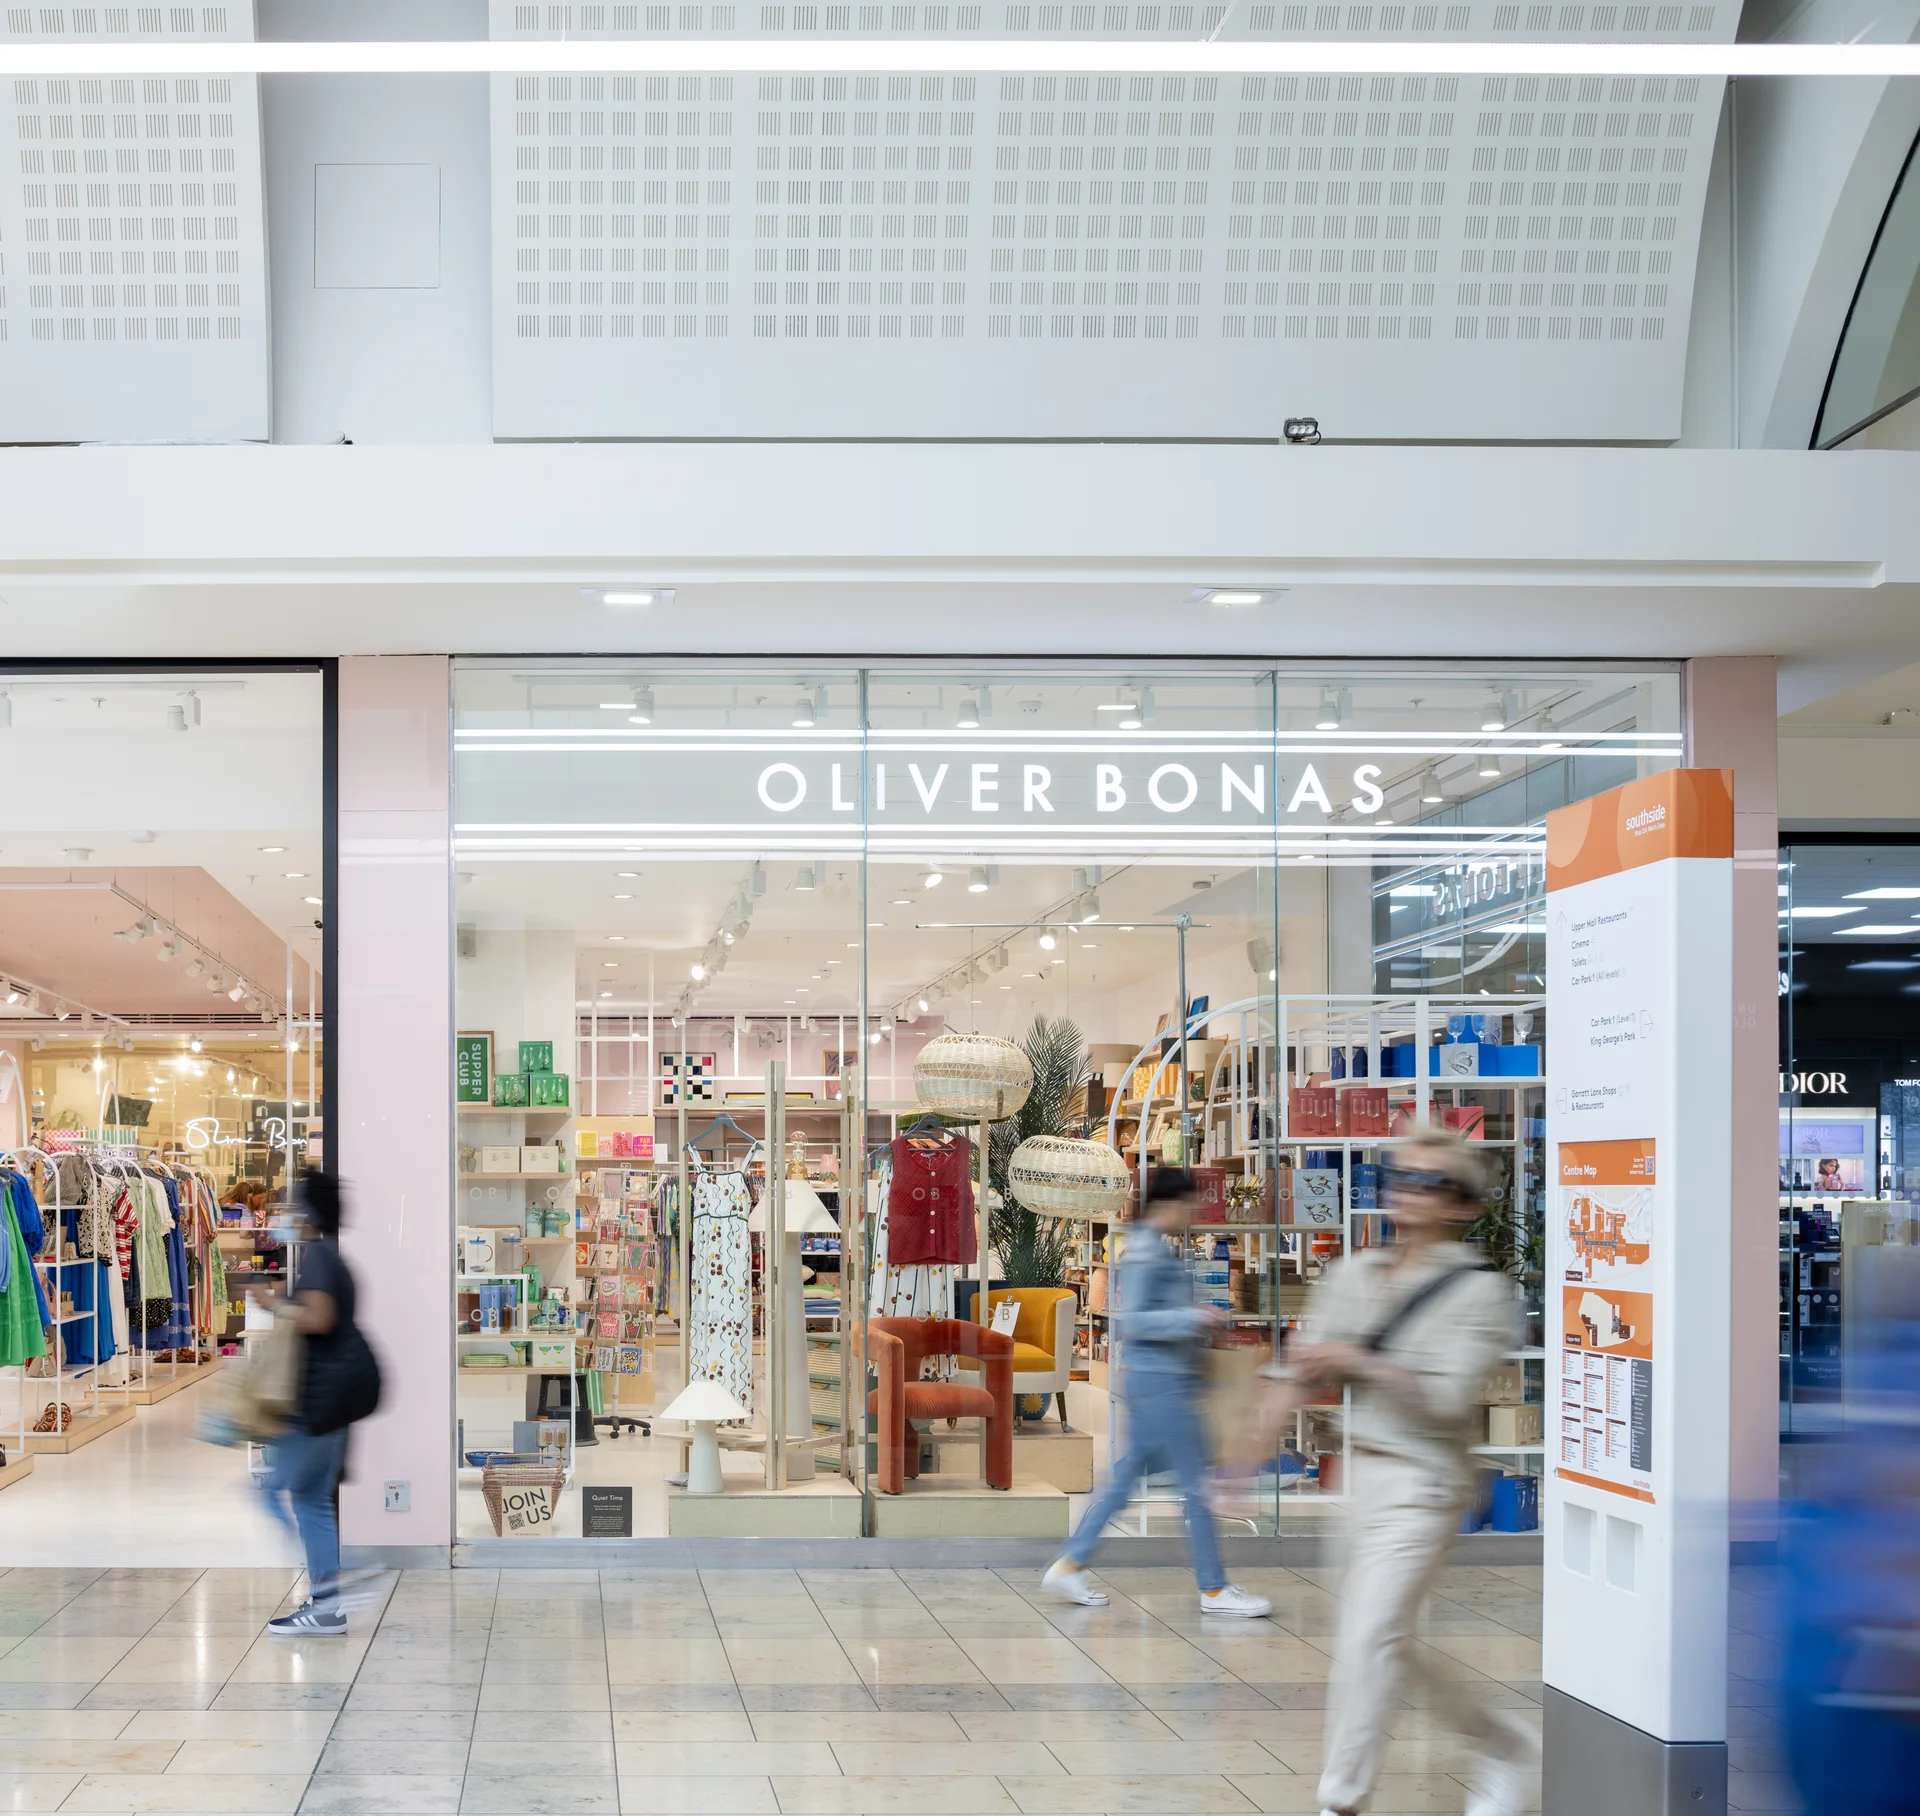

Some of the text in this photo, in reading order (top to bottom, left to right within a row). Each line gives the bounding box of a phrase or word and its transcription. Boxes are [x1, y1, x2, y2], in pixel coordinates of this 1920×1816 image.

[757, 762, 1385, 814] OLIVER BONAS
[1626, 804, 1666, 831] southside
[1572, 912, 1628, 932] Upper Mall Restaurants
[1572, 939, 1590, 950] Cinema
[1572, 957, 1587, 967] Toilets
[1572, 977, 1580, 986] Car
[1581, 974, 1592, 984] Park
[1596, 971, 1604, 983] (All
[1605, 968, 1620, 981] levels)
[1591, 1018, 1600, 1027] Car
[1601, 1016, 1612, 1026] Park
[1616, 1013, 1630, 1025] (Level
[1631, 1012, 1636, 1023] 1)
[1590, 1032, 1636, 1048] King George's Park
[458, 1051, 469, 1086] CLUB
[472, 1042, 481, 1096] SUPPER
[1779, 1072, 1849, 1094] DIOR
[1894, 1079, 1911, 1087] TOM
[1572, 1086, 1617, 1098] Garratt Lane Shops
[1572, 1101, 1604, 1111] & Restaurants
[185, 1116, 253, 1149] Oliver
[1563, 1164, 1597, 1178] Centre Map
[470, 1187, 496, 1200] OB
[546, 1187, 574, 1200] OB
[912, 1187, 940, 1201] OB
[985, 1187, 1013, 1200] OB
[1204, 1187, 1232, 1201] OB
[471, 1309, 497, 1322] OB
[916, 1309, 944, 1323] OB
[983, 1308, 1010, 1321] OB
[1633, 1479, 1651, 1489] southside
[503, 1488, 546, 1514] JOIN
[526, 1505, 551, 1525] US
